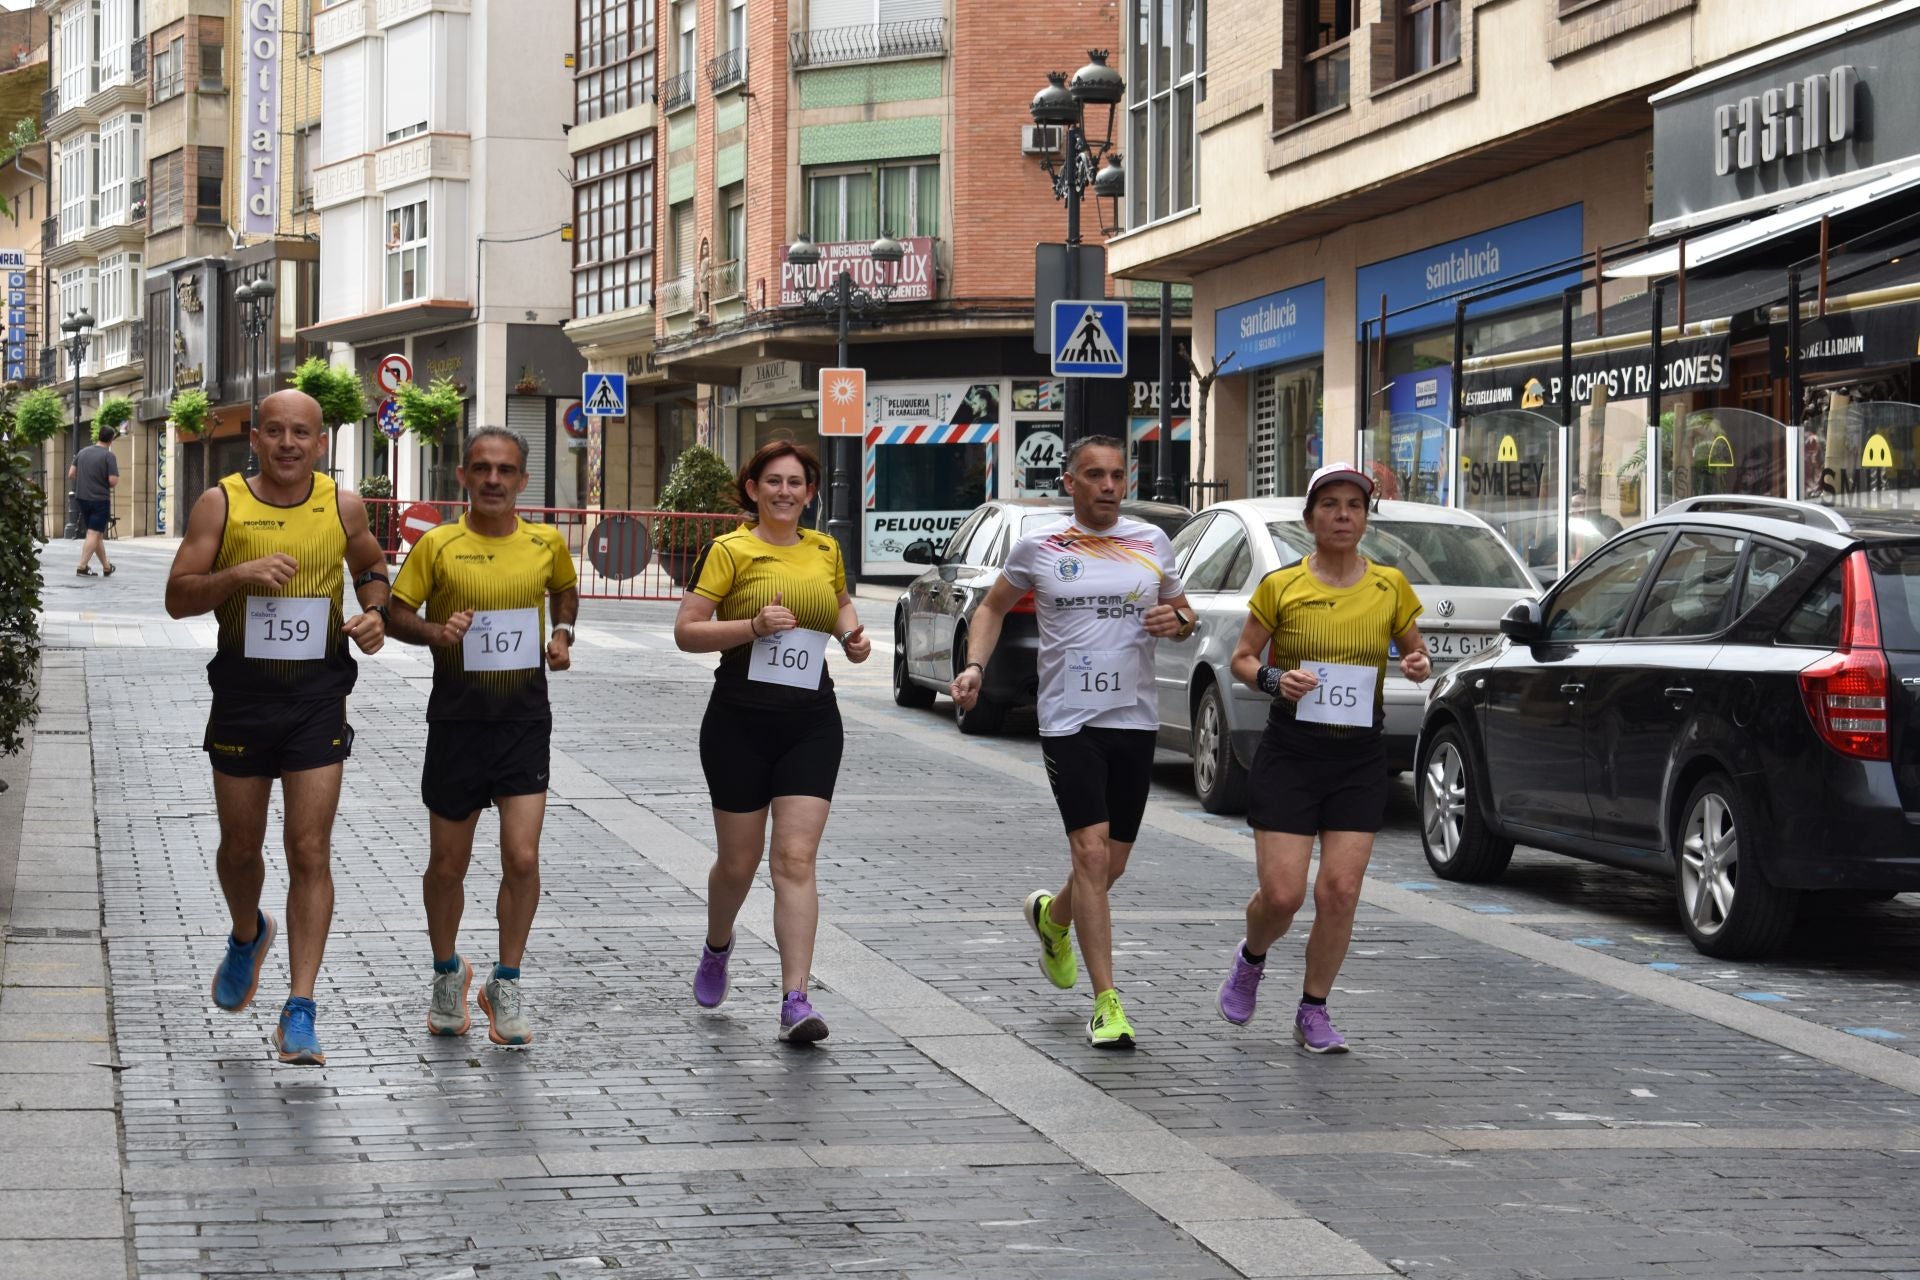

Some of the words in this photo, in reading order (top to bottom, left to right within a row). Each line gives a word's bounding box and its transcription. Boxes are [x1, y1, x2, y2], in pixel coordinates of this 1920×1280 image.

[250, 0, 277, 217] Gottard
[893, 254, 928, 284] LUX
[1426, 241, 1500, 290] santalucía
[10, 274, 23, 379] OPTICA
[1240, 297, 1297, 339] santalucía
[1551, 370, 1618, 403] PNCHOS
[1621, 367, 1632, 394] Y
[874, 516, 966, 533] PELUQUE
[264, 619, 310, 642] 159
[480, 630, 523, 654] 167
[767, 646, 809, 671] 160
[1080, 671, 1122, 692] 161
[1314, 684, 1357, 708] 165
